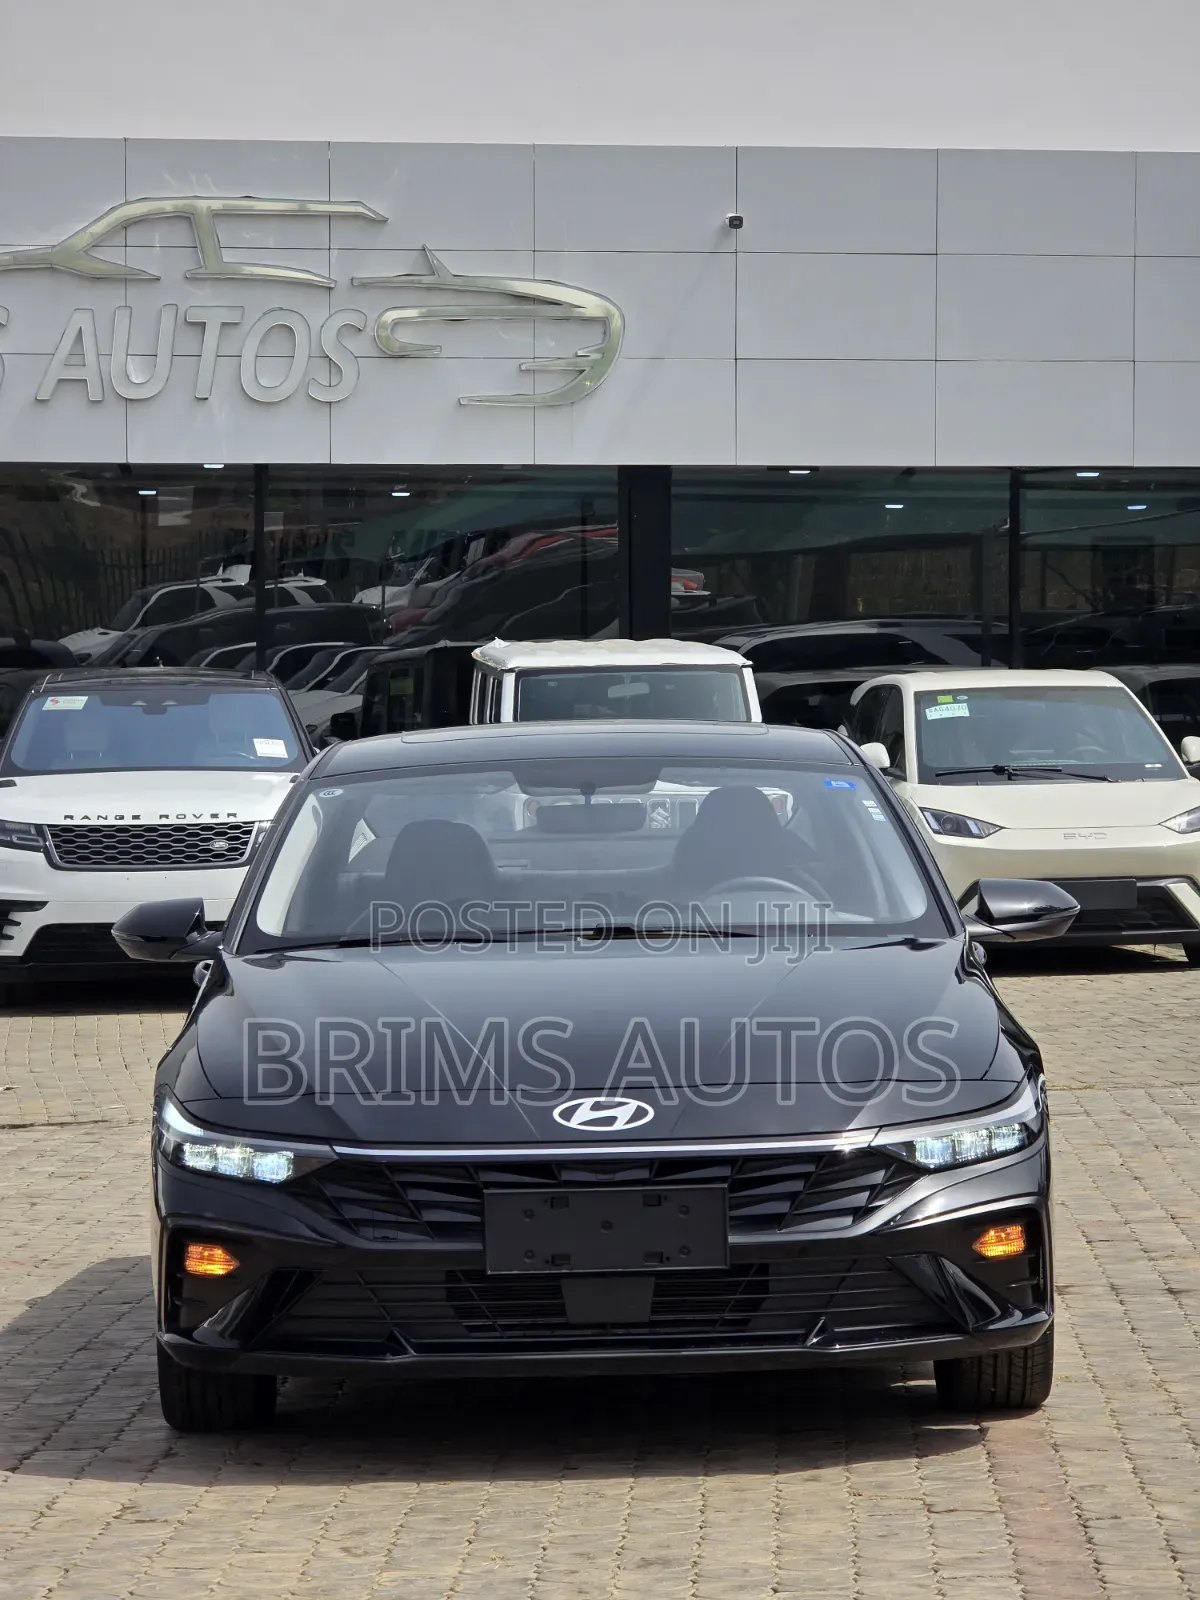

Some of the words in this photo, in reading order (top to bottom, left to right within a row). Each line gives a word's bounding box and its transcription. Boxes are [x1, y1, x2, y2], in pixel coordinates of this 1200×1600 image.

[35, 303, 367, 402] AUTOS
[159, 812, 238, 820] ROVER
[1063, 832, 1107, 840] BYD
